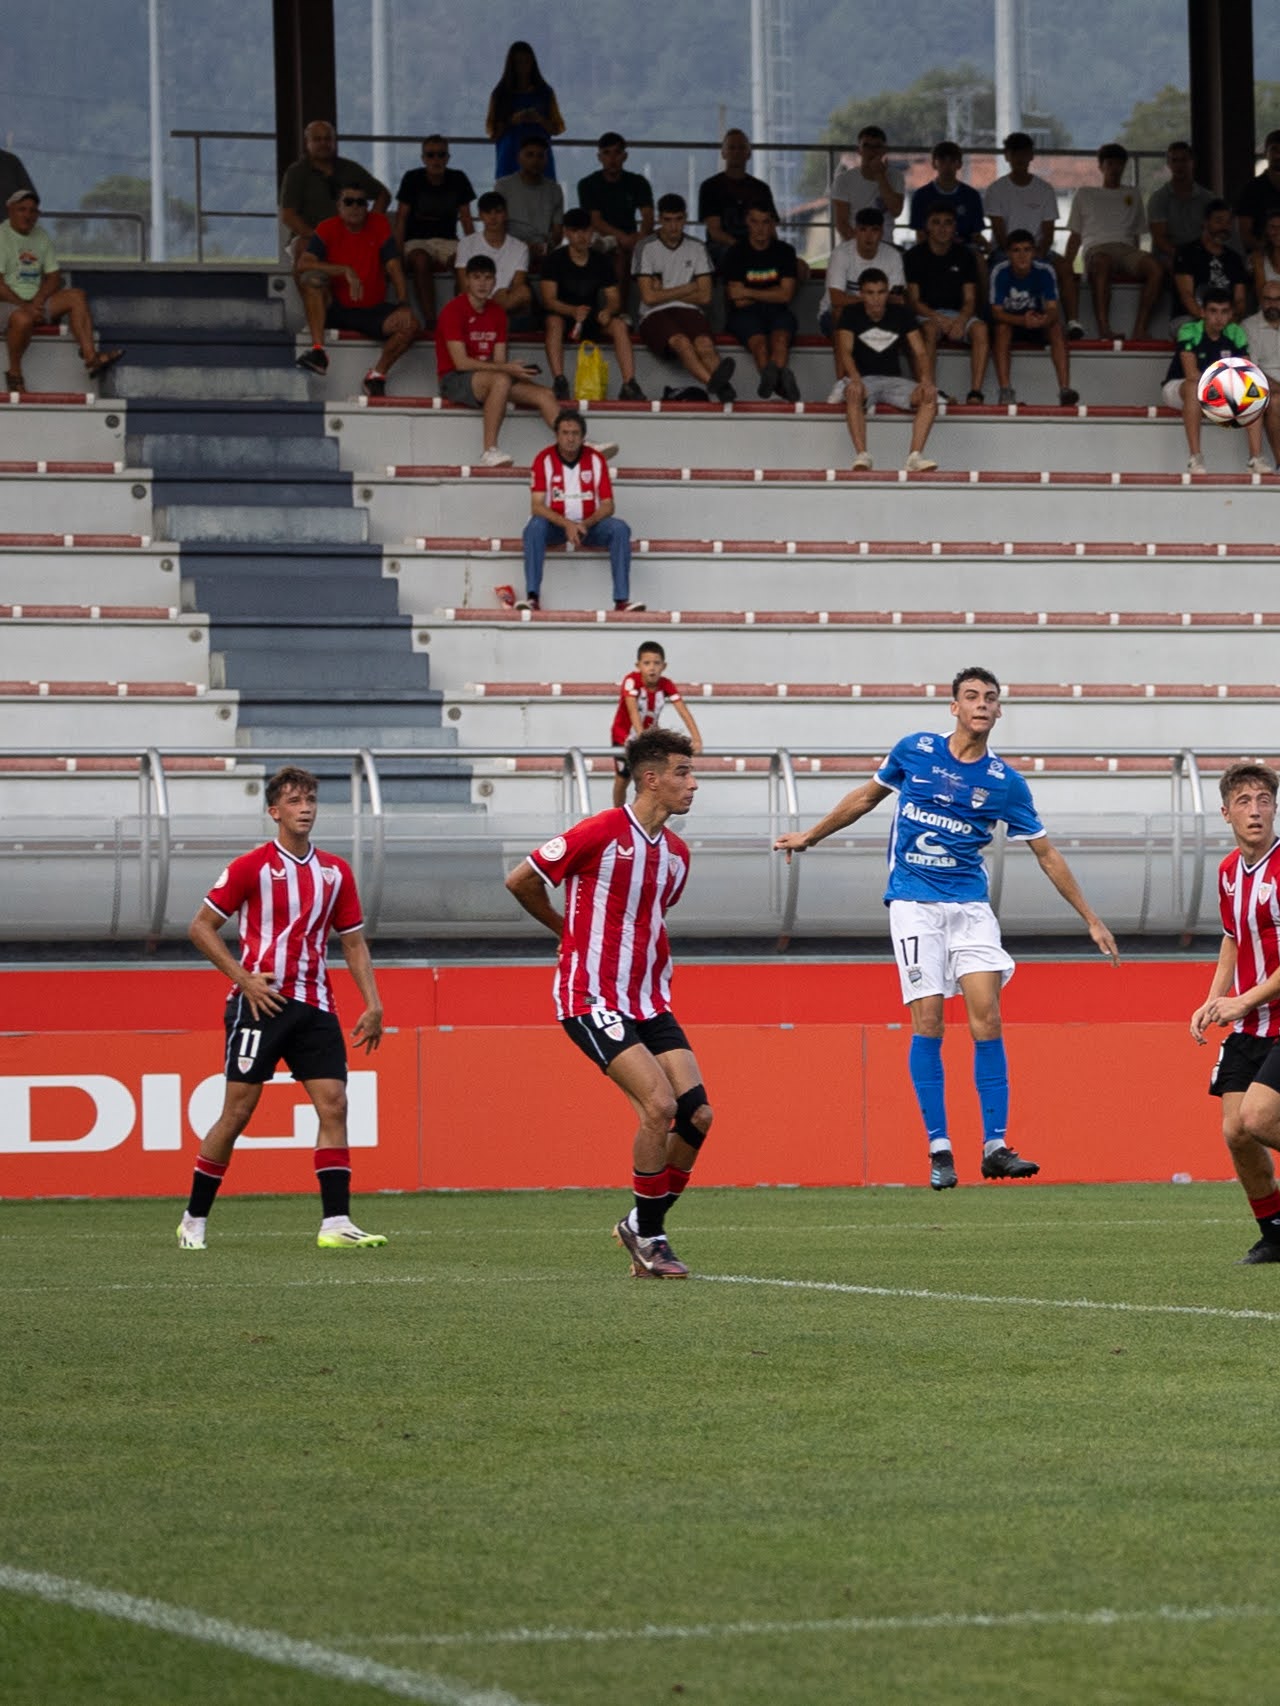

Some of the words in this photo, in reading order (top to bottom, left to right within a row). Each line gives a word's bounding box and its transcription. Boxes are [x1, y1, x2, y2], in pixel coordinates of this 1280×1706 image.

[902, 801, 972, 835] Alcampo
[900, 935, 919, 967] 17
[239, 1027, 262, 1058] 11
[0, 1070, 379, 1153] DIGI
